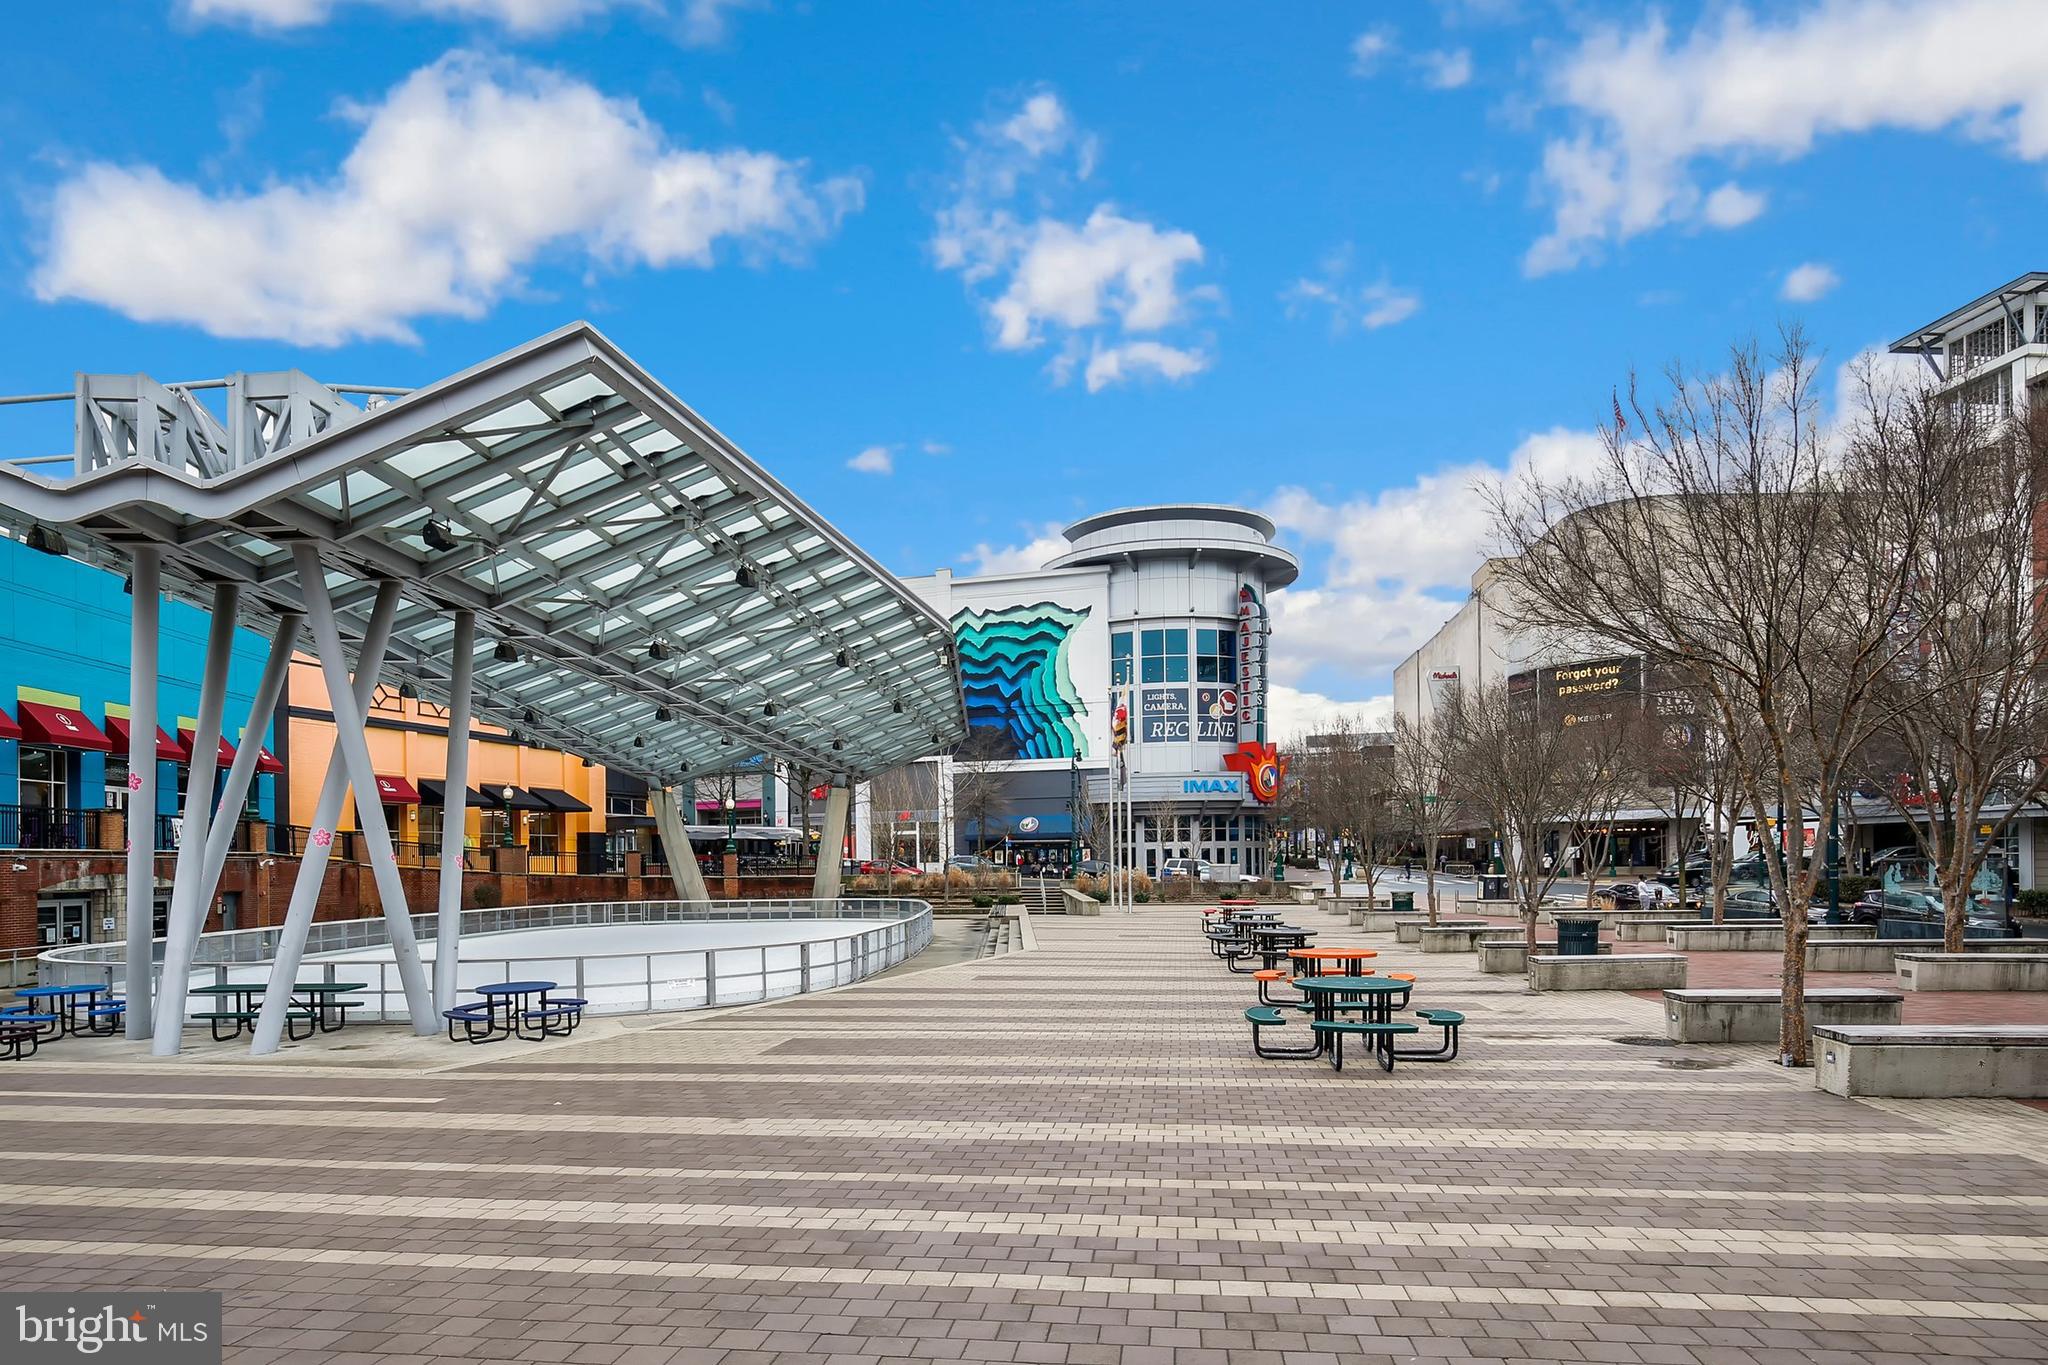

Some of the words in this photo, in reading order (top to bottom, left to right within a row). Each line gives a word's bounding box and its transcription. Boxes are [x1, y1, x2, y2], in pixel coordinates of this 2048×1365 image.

[1239, 606, 1251, 721] MAJESTIC
[1556, 667, 1592, 681] Forgot
[1595, 665, 1622, 678] your
[1558, 678, 1619, 697] password?
[1144, 703, 1187, 711] CAMERA,
[1183, 779, 1239, 793] IMAX
